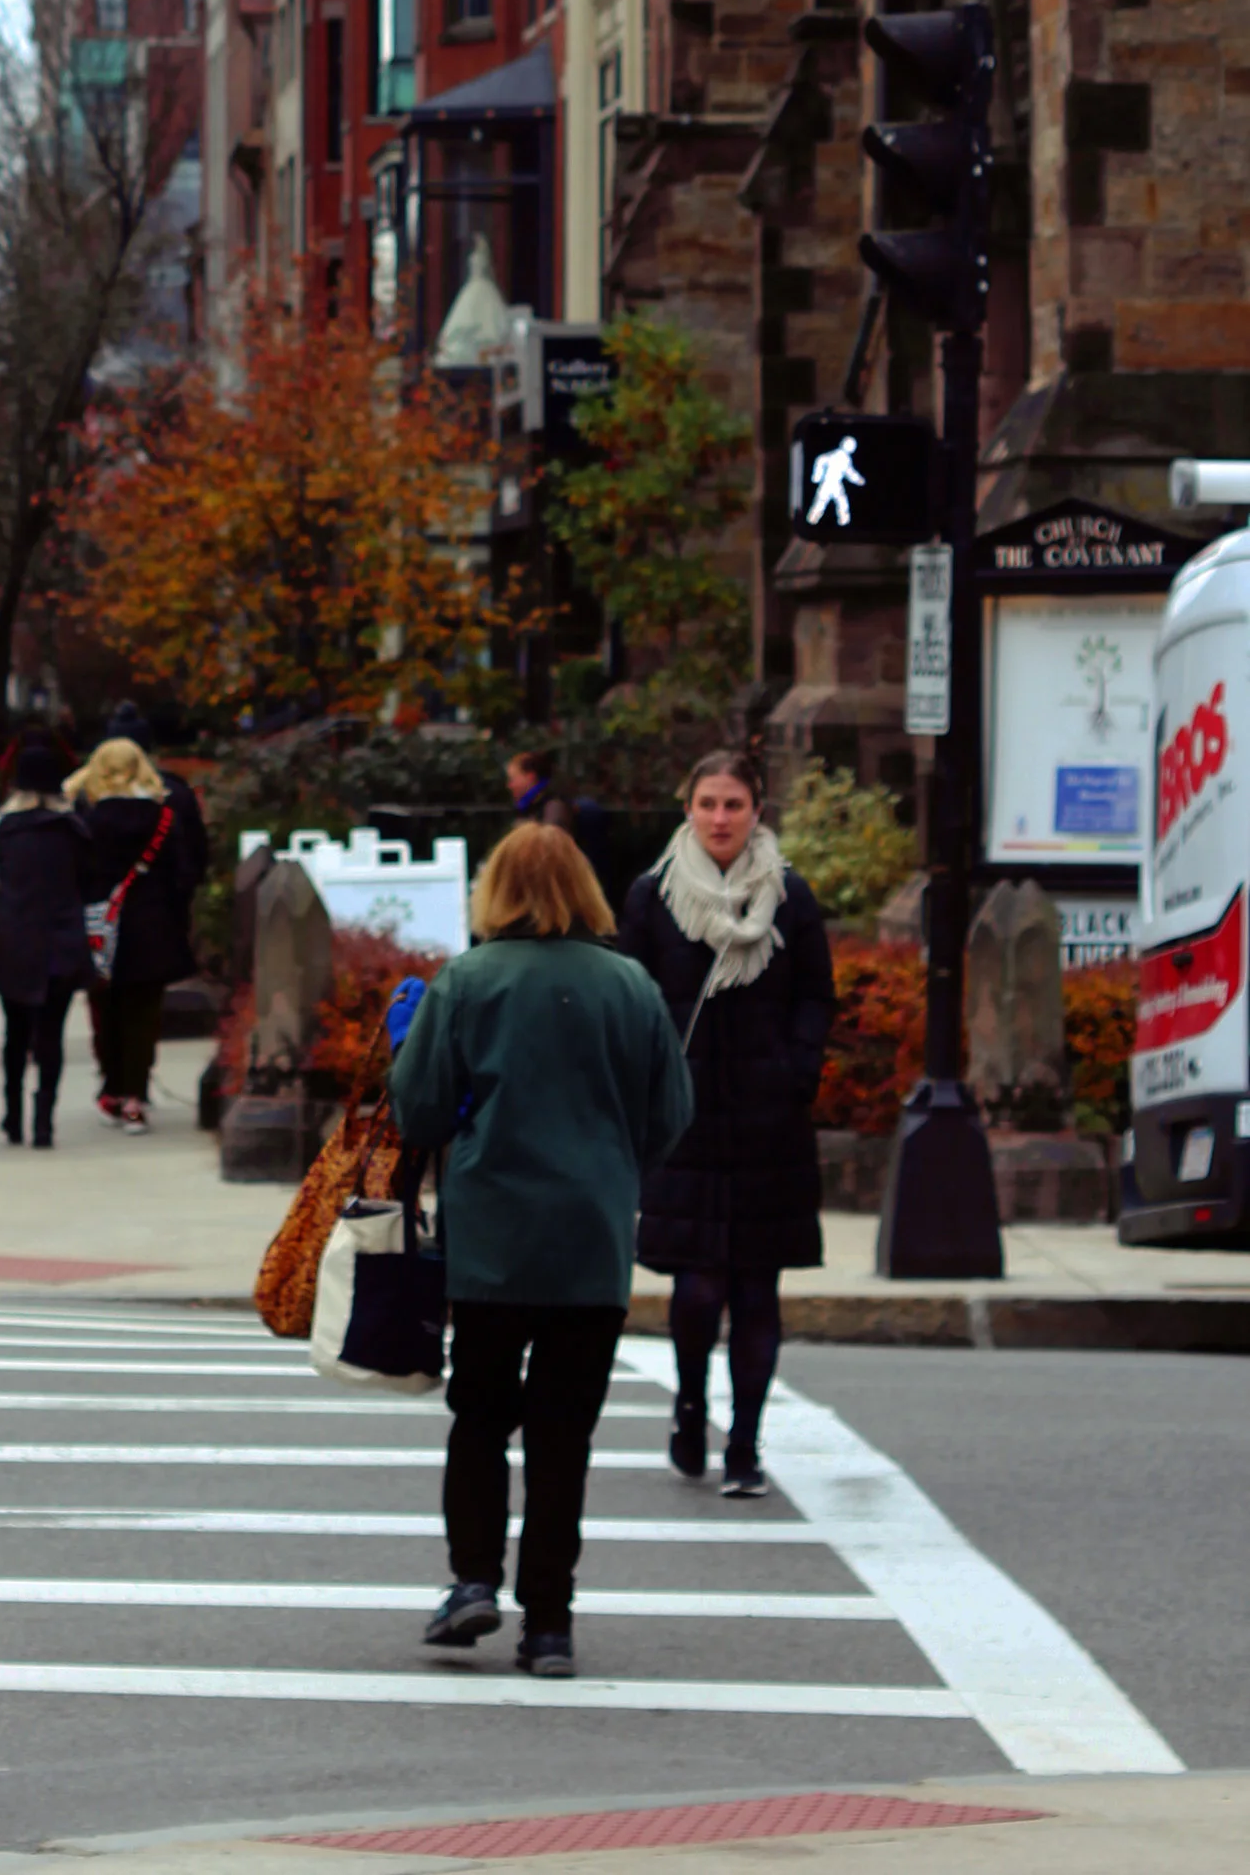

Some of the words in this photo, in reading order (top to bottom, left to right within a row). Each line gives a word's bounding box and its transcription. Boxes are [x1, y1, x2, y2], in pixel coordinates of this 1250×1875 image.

[1034, 516, 1123, 545] CHURCH
[994, 545, 1034, 568] THE
[1043, 541, 1166, 568] COVENANT
[1059, 910, 1131, 937] BLACK
